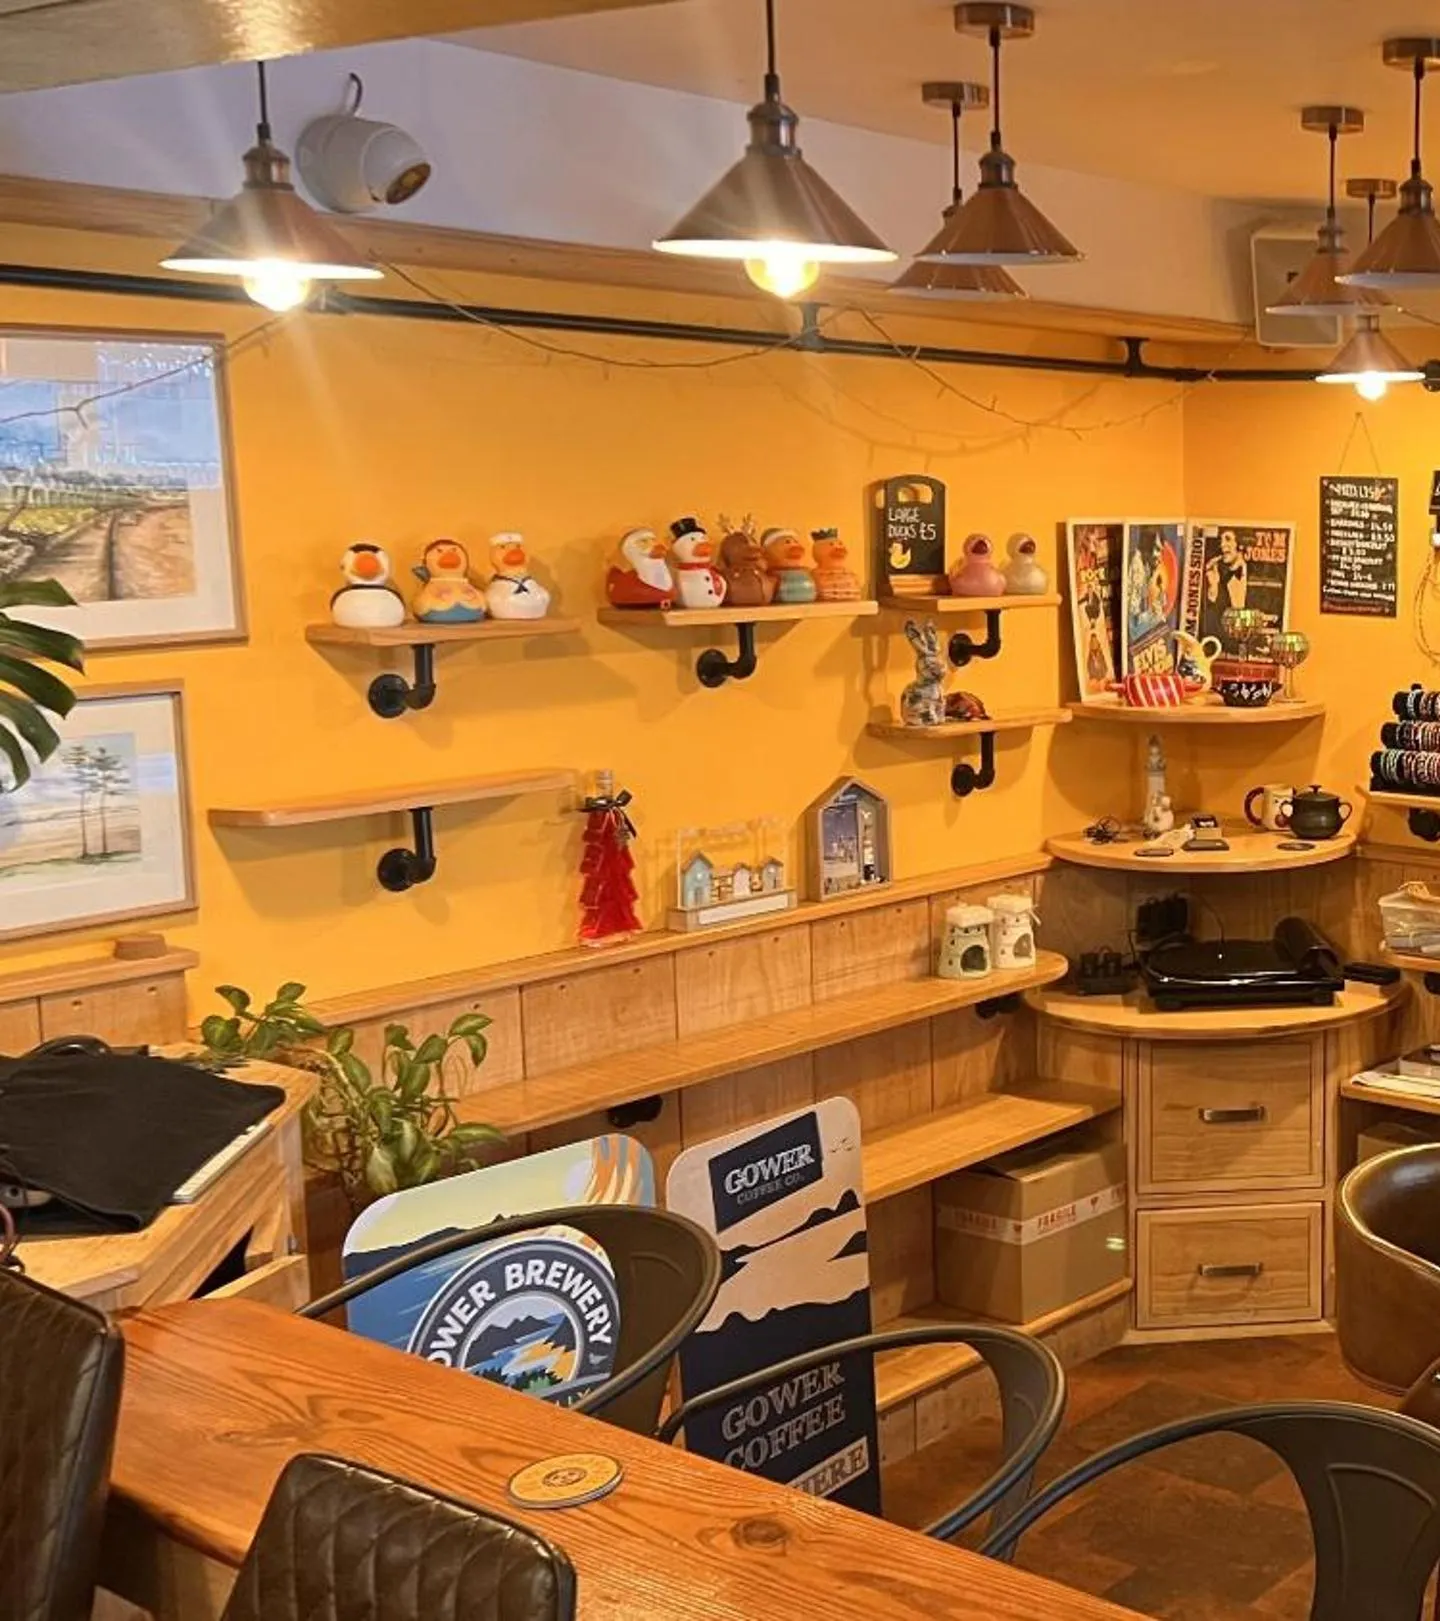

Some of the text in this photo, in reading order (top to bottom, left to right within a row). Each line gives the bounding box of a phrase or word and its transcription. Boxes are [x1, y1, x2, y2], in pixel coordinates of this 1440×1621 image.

[888, 507, 920, 523] LARGE
[919, 522, 936, 540] £5
[1256, 531, 1286, 548] TOM
[1244, 547, 1286, 563] JONES
[724, 1144, 815, 1194] GOWER
[737, 1178, 782, 1204] COFFEE
[427, 1258, 612, 1367] OWER BREWERY
[722, 1361, 846, 1441] GOWER
